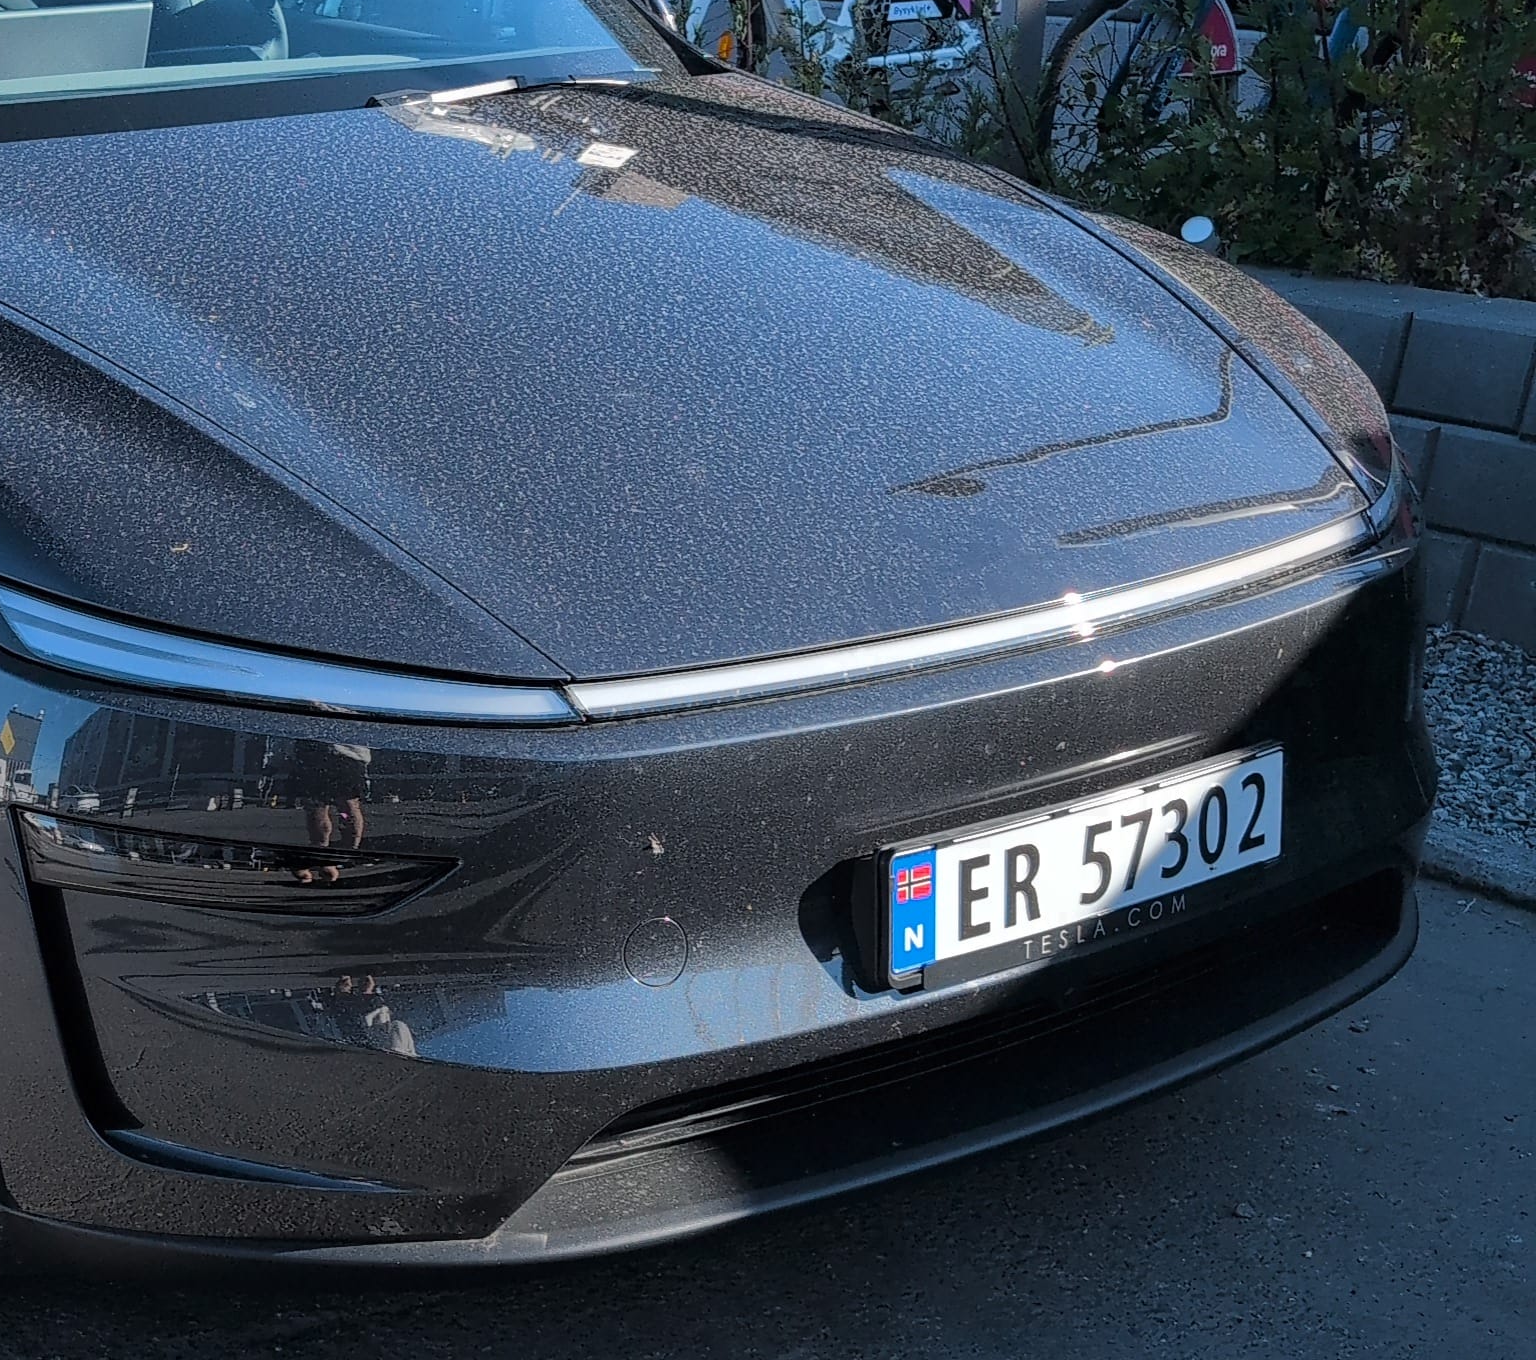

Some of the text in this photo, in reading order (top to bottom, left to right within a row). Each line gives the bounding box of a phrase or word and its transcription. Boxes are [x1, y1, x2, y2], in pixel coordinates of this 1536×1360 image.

[958, 772, 1266, 942] ER 57302
[904, 924, 924, 951] N
[1023, 894, 1186, 959] TESLA.COM
